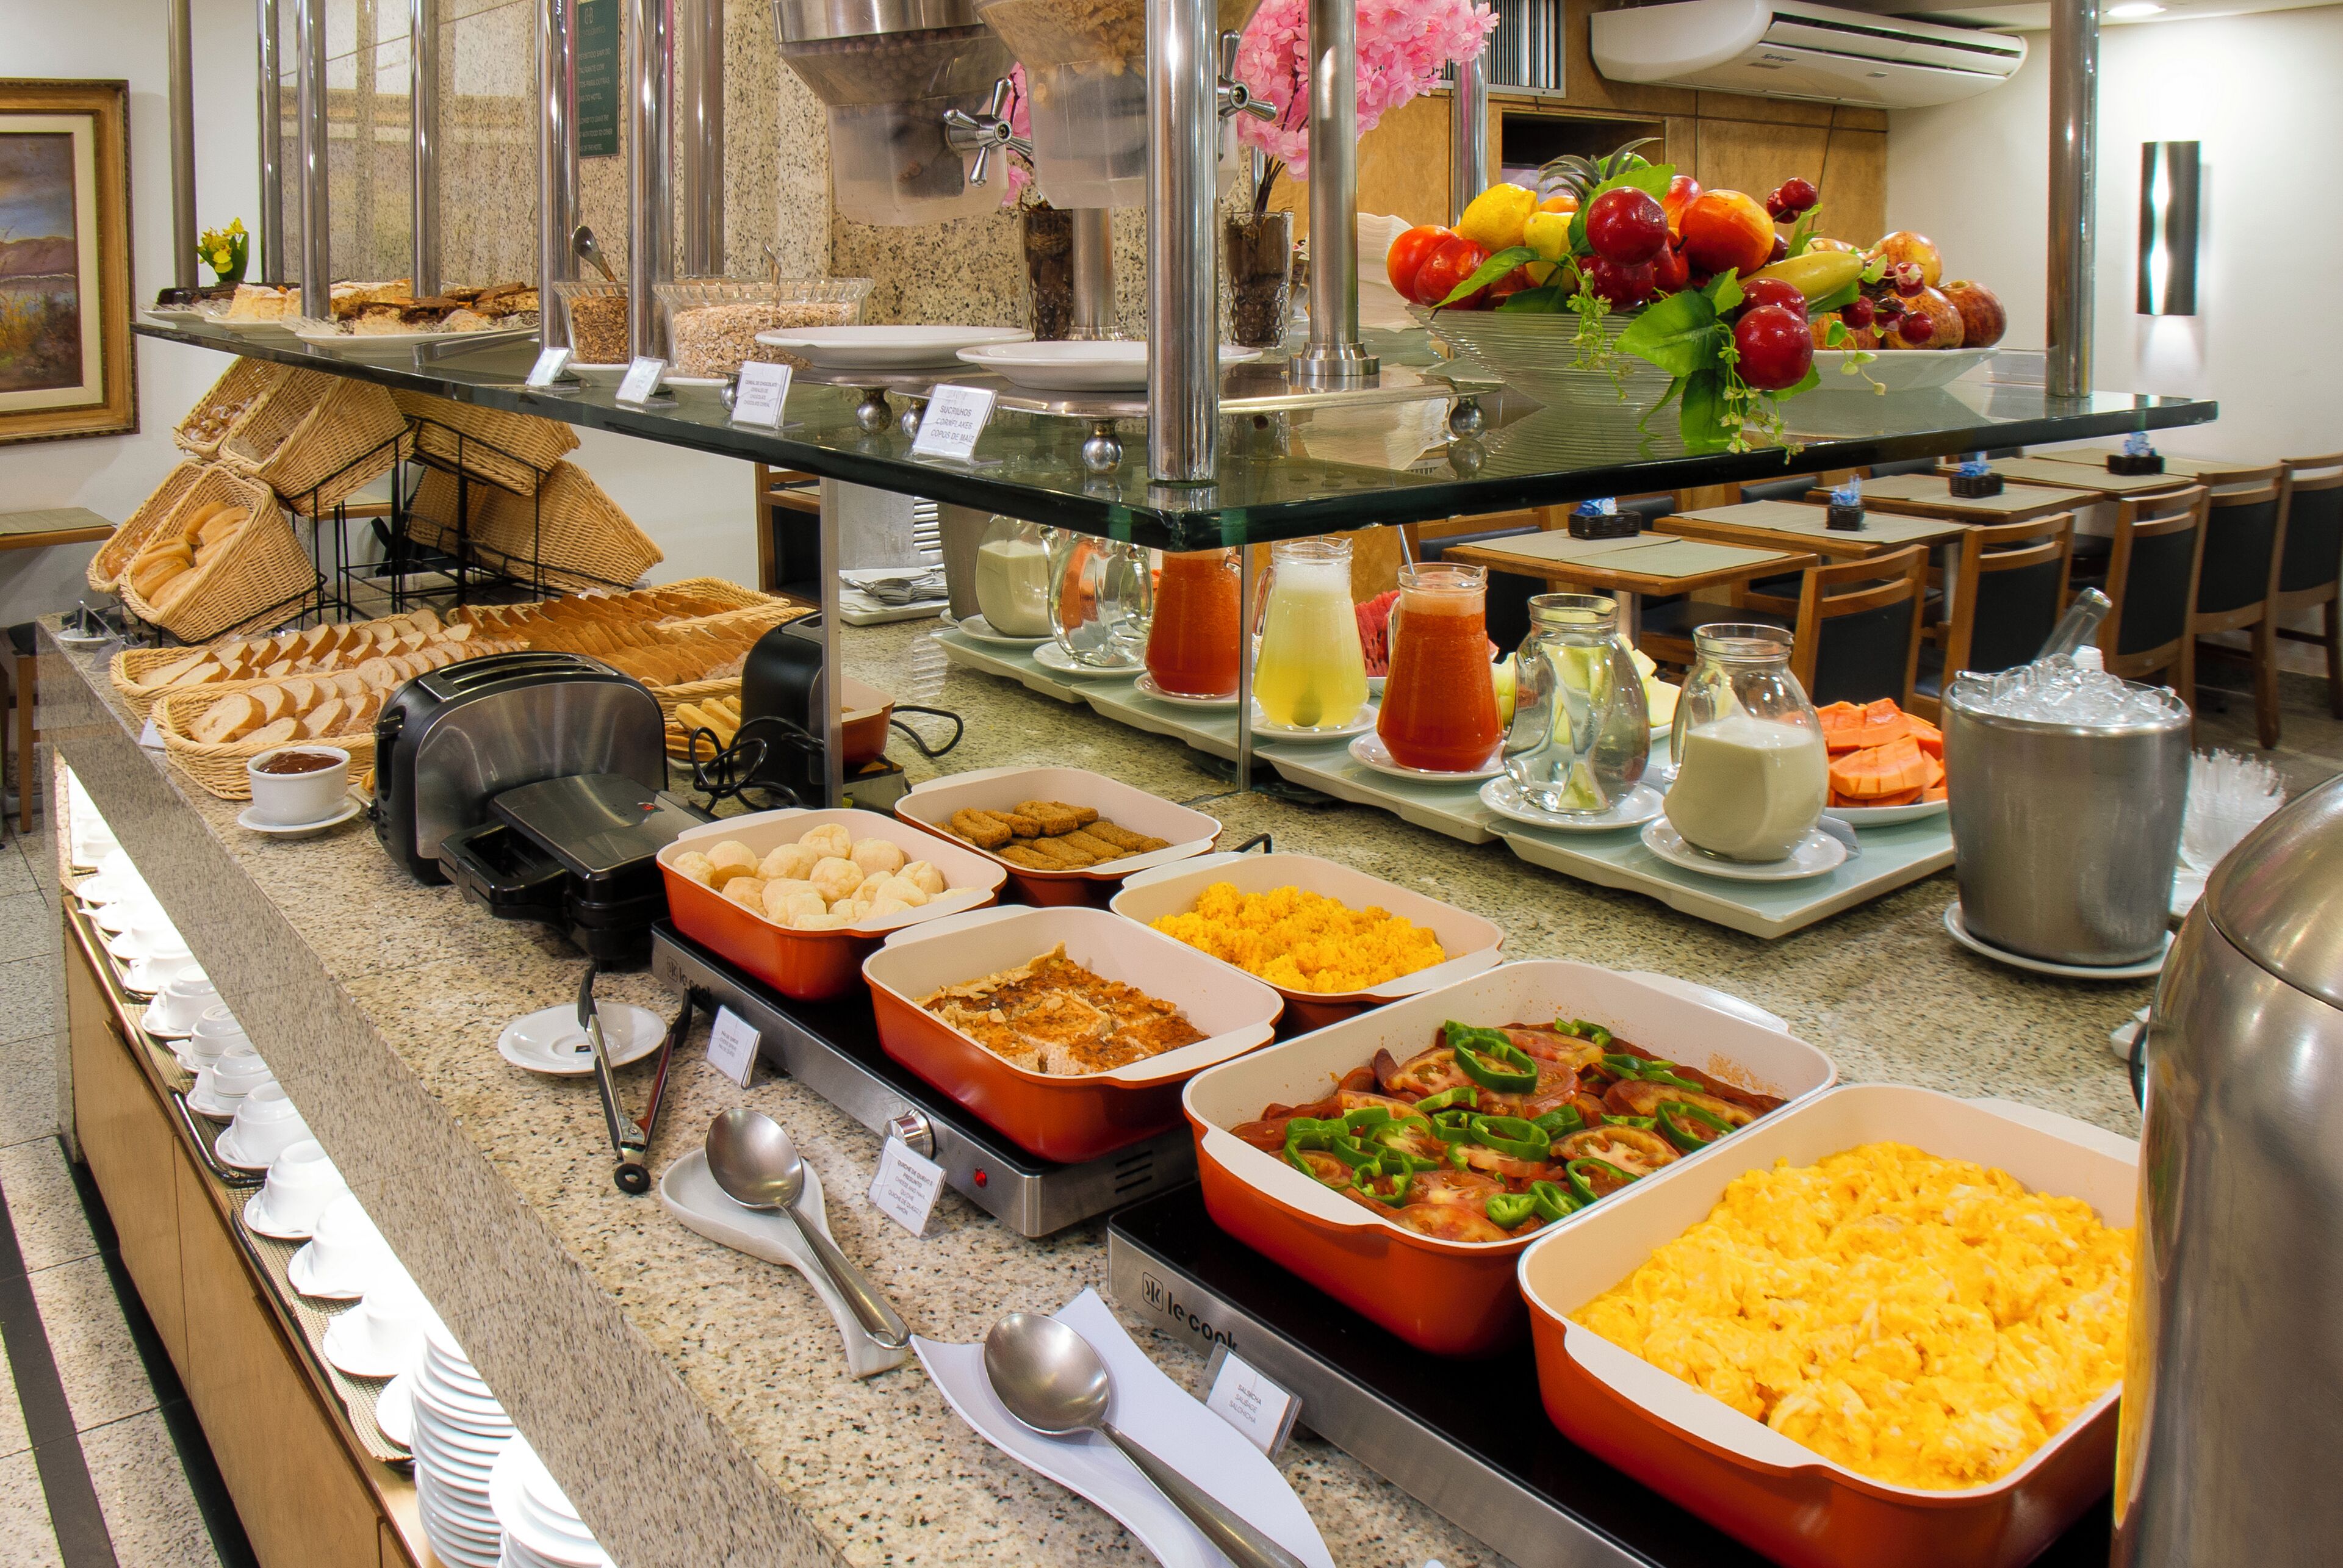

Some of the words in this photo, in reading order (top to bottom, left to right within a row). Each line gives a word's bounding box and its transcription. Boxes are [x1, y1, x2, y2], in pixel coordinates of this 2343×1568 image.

[940, 405, 972, 417] SUCRILHOS
[936, 417, 973, 430] CORNFLAKES
[930, 429, 951, 439] COPOS
[951, 432, 960, 441] DE
[1167, 1290, 1185, 1323] le
[1234, 1393, 1258, 1414] SAUSAGE
[1237, 1383, 1262, 1406] SALSICHA
[1228, 1399, 1257, 1424] SALCHICHA
